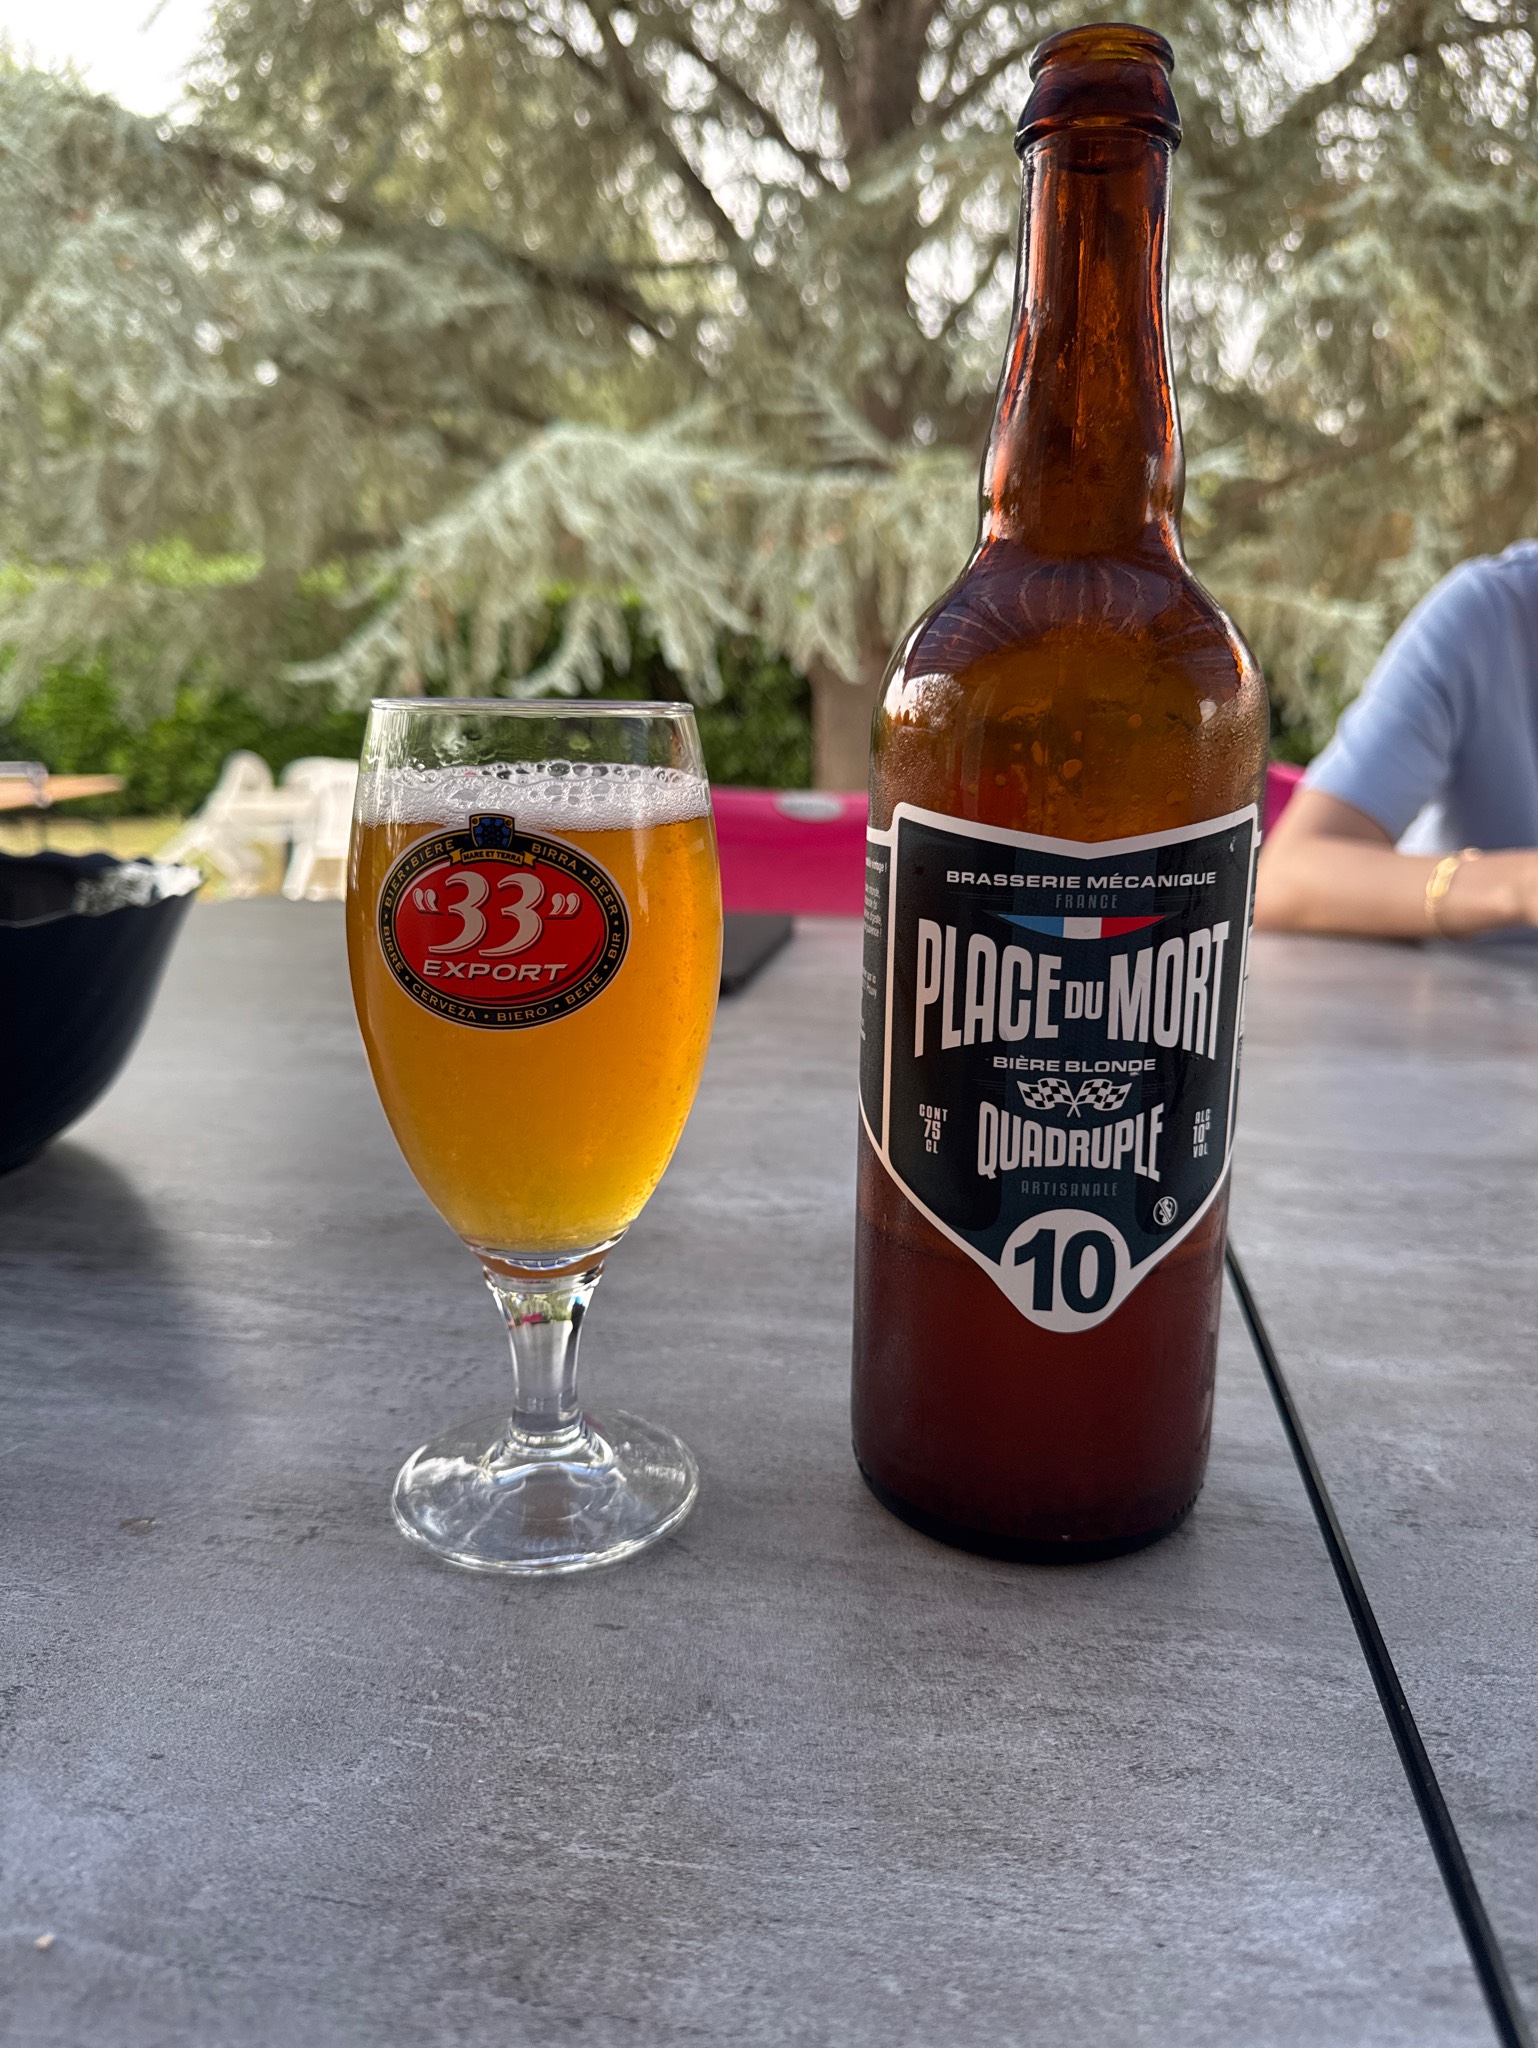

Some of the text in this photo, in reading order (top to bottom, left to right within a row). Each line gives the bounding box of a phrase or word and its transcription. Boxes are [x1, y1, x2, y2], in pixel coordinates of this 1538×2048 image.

[410, 839, 455, 868] BIÈRE
[463, 850, 521, 863] MARE ET TERRA
[531, 843, 577, 871] BIRRA
[385, 869, 406, 908] BIER
[946, 870, 1217, 889] BRASSERIE MÉCANIQUE
[590, 876, 618, 916] BEER
[1055, 893, 1118, 909] FRANCE
[608, 932, 621, 959] BIR
[423, 959, 568, 981] EXPORT
[412, 973, 603, 1022] CERVEZA BIERO BERE
[914, 917, 1230, 1060] PLACE DU MORT
[993, 1055, 1156, 1073] BIÈRE BLONDE
[919, 1103, 948, 1122] CONT
[1194, 1108, 1211, 1125] ALC
[923, 1118, 941, 1140] 75
[925, 1138, 939, 1154] CL
[977, 1101, 1165, 1182] QUADRUPLE
[1193, 1142, 1208, 1158] VOL
[1021, 1180, 1118, 1197] ARTISANALE
[1014, 1228, 1116, 1313] 10
